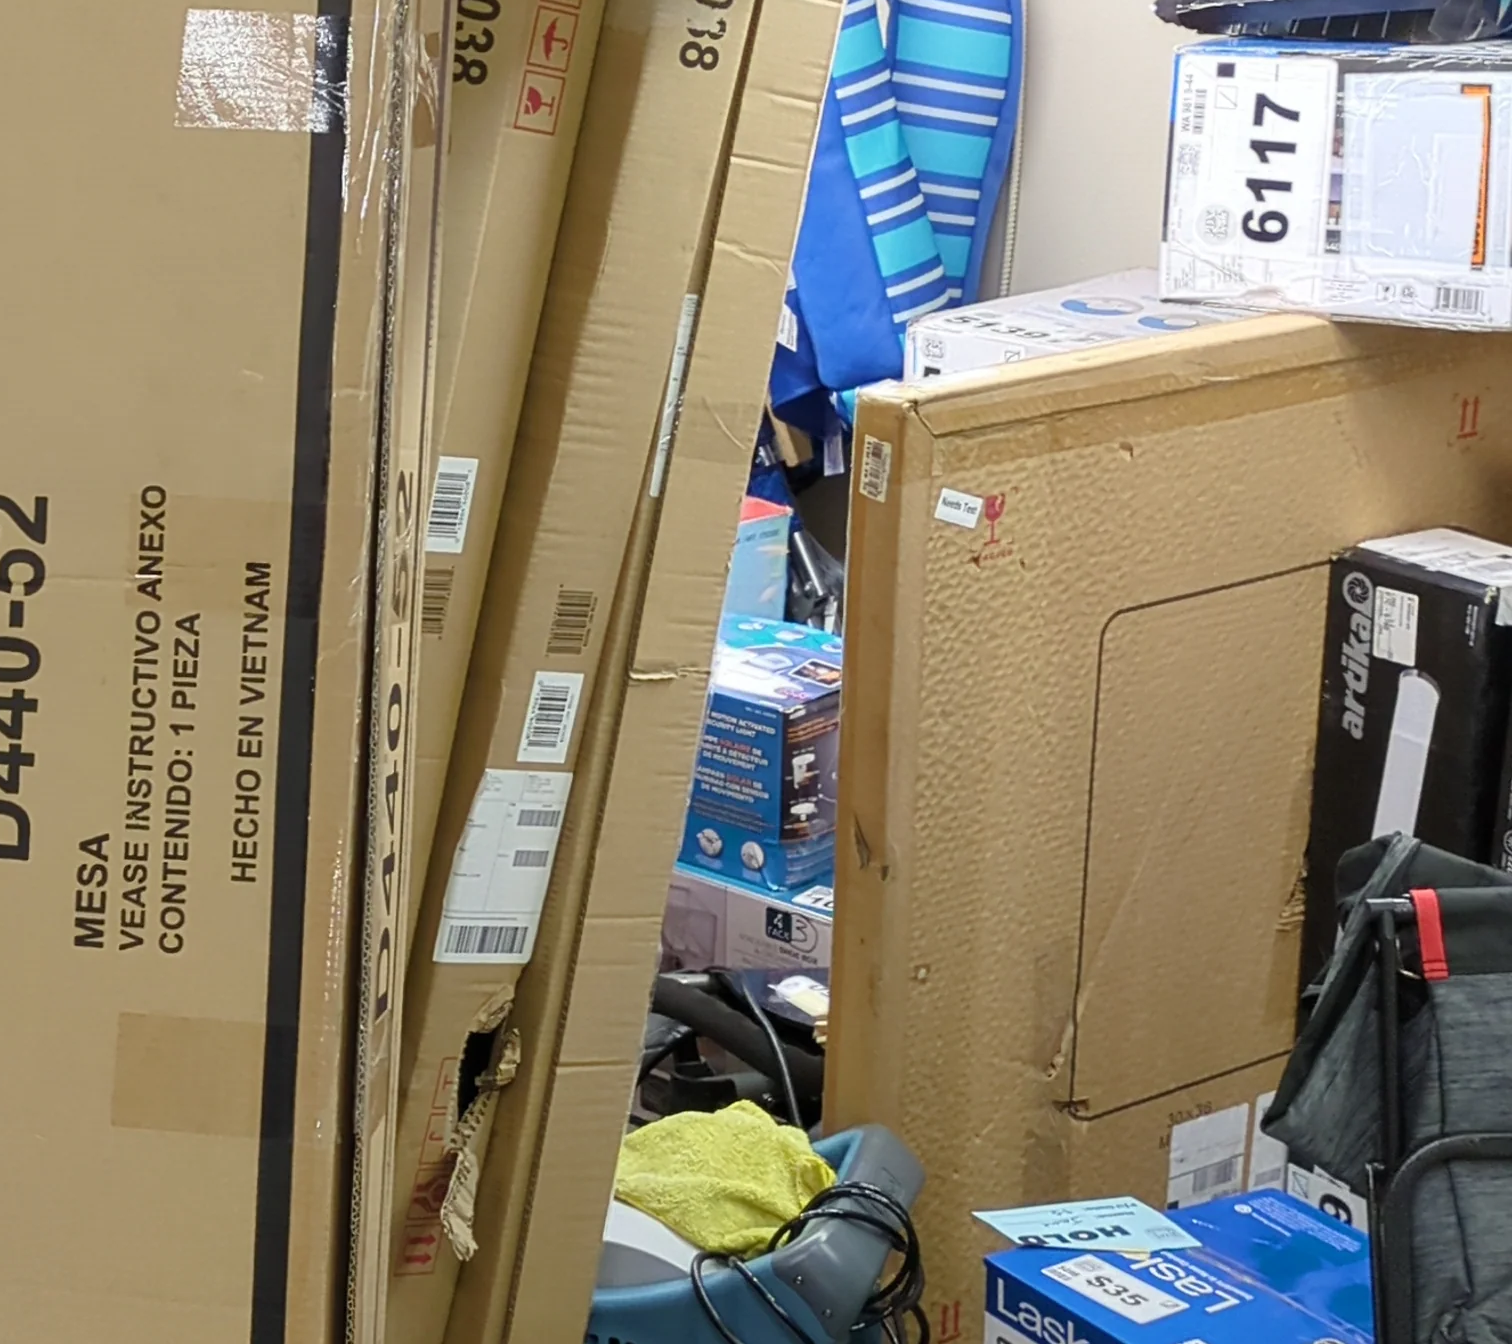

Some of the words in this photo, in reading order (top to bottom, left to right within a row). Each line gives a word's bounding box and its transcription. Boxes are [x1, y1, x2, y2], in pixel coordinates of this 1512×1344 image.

[1180, 115, 1192, 133] WA
[1242, 92, 1301, 244] 6117
[138, 484, 167, 602] ANEXO
[940, 496, 963, 511] Needs
[962, 501, 979, 516] Test
[172, 611, 201, 708] PIEZA
[244, 561, 272, 708] VIETNAM
[1342, 606, 1374, 741] artika
[126, 609, 161, 828] INSTRUCTIVO
[172, 719, 193, 737] 1
[238, 714, 264, 760] EN
[373, 469, 414, 1019] D440-52
[158, 746, 194, 955] CONTENIDO:
[231, 769, 260, 884] HECHO
[74, 831, 110, 950] MESA
[119, 840, 149, 952] VEASE
[1017, 1223, 1131, 1247] HOLD
[1086, 1274, 1150, 1308] $35
